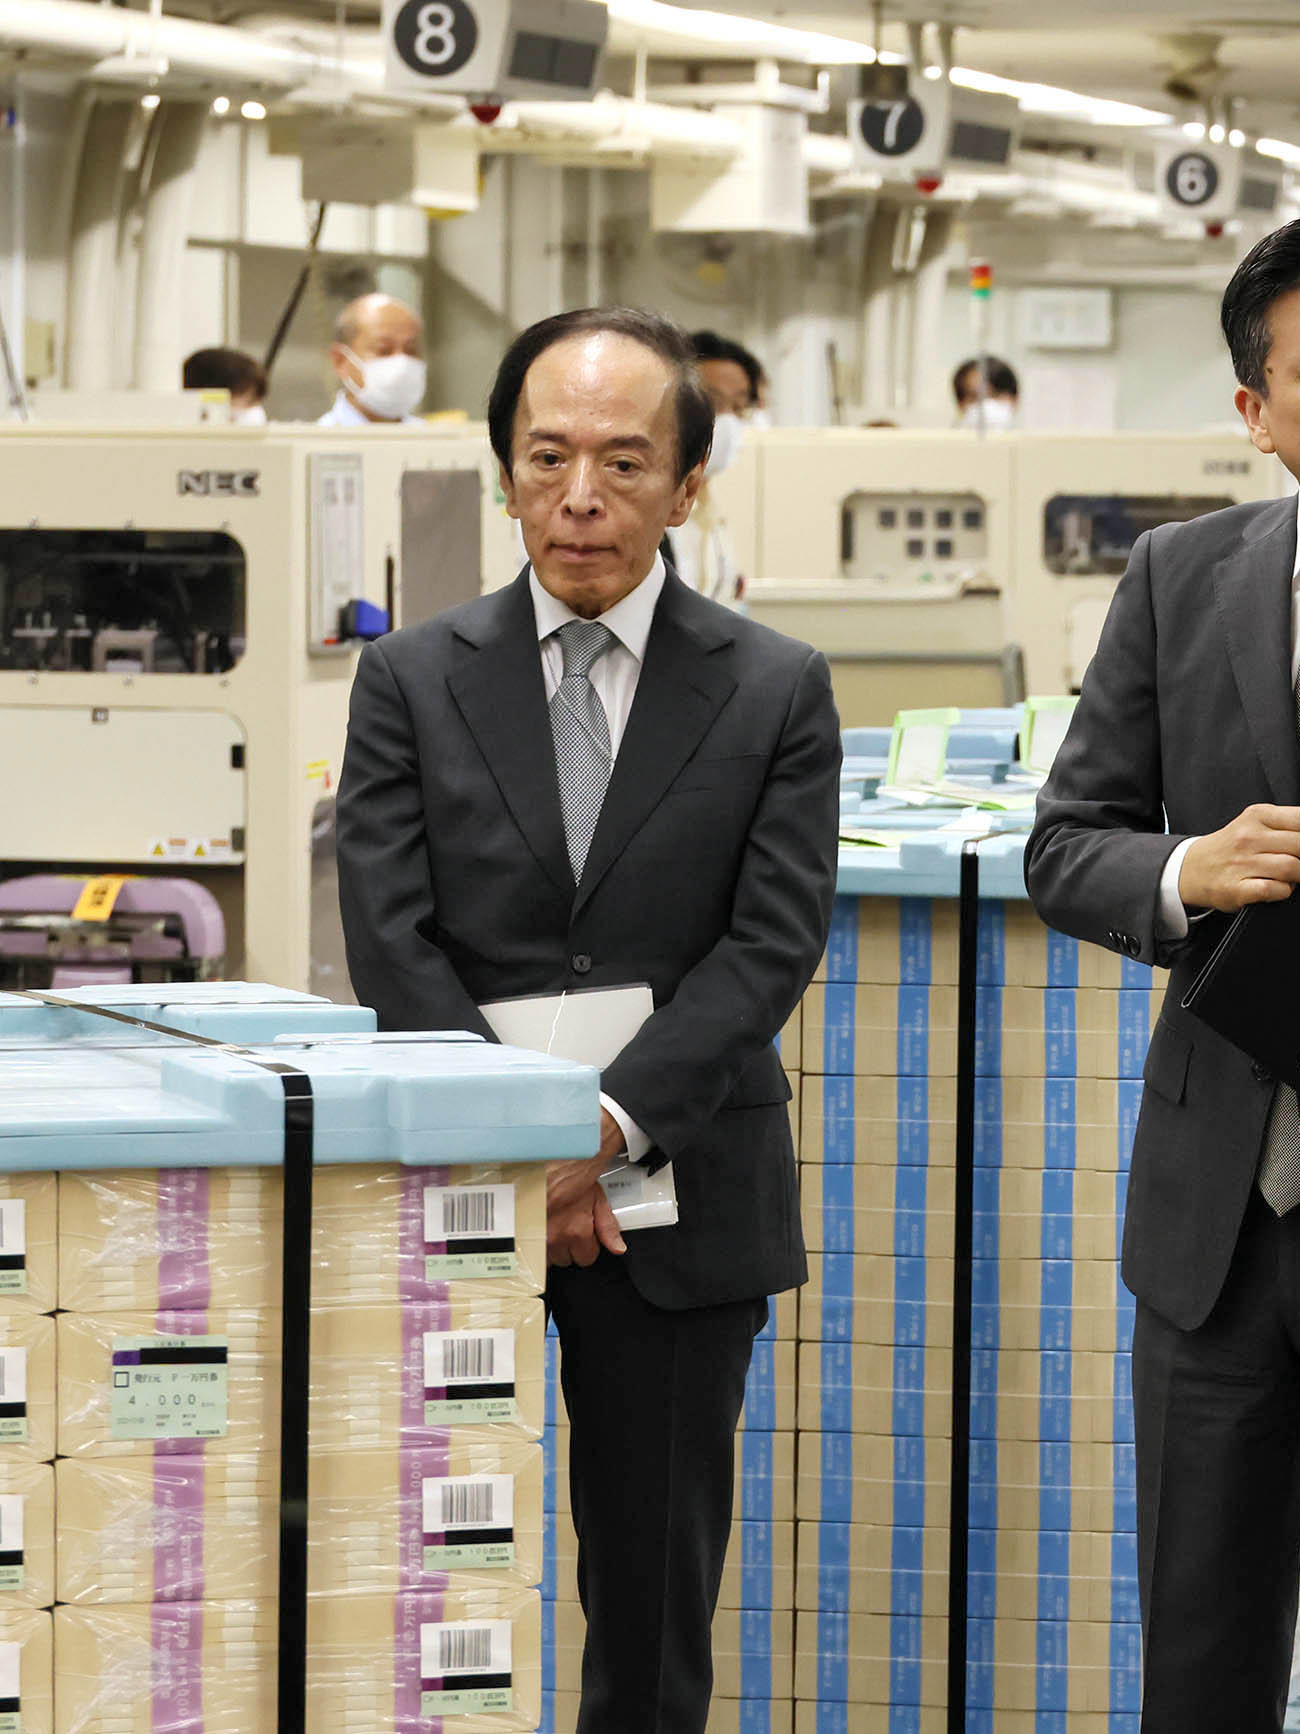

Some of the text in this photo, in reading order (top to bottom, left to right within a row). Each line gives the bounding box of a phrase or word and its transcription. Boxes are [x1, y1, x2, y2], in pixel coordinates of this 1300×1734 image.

[414, 3, 457, 65] 8
[877, 100, 906, 148] 7
[1177, 157, 1208, 202] 6
[178, 469, 260, 497] NEC
